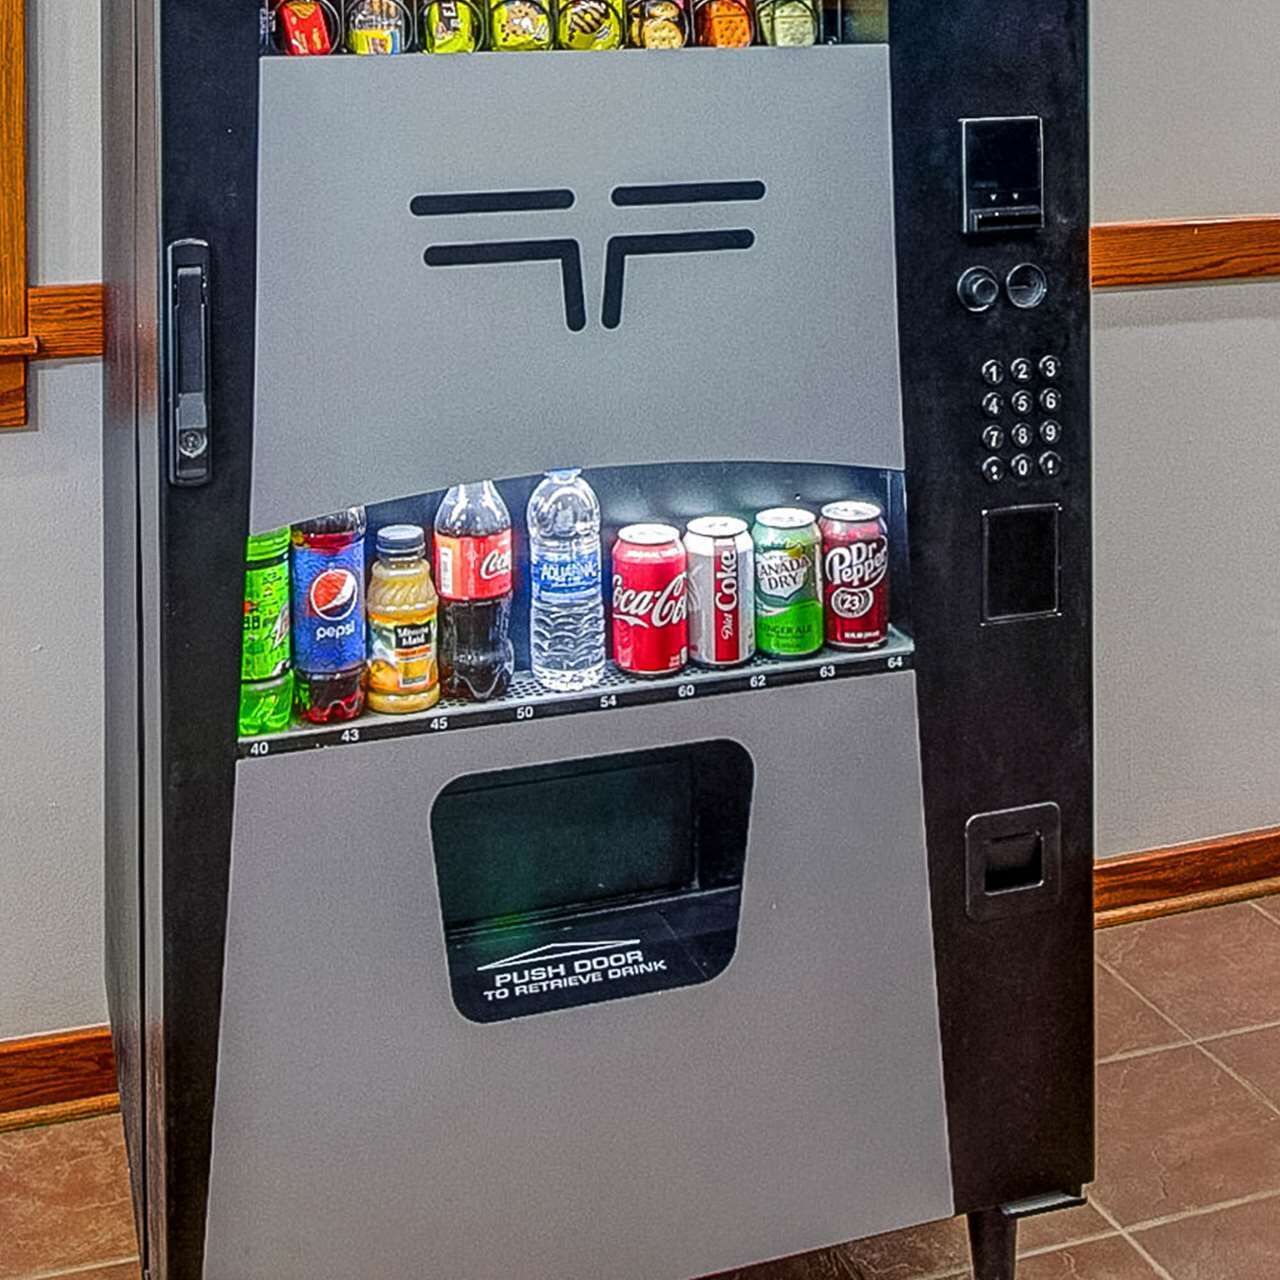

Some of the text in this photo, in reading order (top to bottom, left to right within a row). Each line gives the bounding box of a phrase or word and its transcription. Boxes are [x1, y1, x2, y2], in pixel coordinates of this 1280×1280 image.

[989, 361, 1056, 382] 1 2 3
[988, 392, 1056, 414] 4 5 6
[989, 424, 1056, 447] 7 8 9
[1018, 459, 1028, 476] 0
[850, 542, 878, 565] Dr
[759, 556, 810, 577] ANADA
[827, 546, 889, 586] Pepper
[767, 572, 800, 591] DRY
[716, 550, 738, 640] Diet Coke
[843, 594, 860, 610] 23
[316, 620, 356, 641] pepsi
[820, 665, 836, 678] 63
[888, 656, 903, 669] 64
[750, 675, 767, 687] 62
[678, 684, 695, 697] 60
[600, 695, 617, 708] 54
[517, 706, 533, 719] 50
[430, 718, 448, 730] 45
[341, 729, 360, 742] 43
[250, 742, 269, 755] 40
[495, 950, 644, 988] PUSH DOOR
[483, 959, 668, 1001] TO RETRIEVE DRINK
